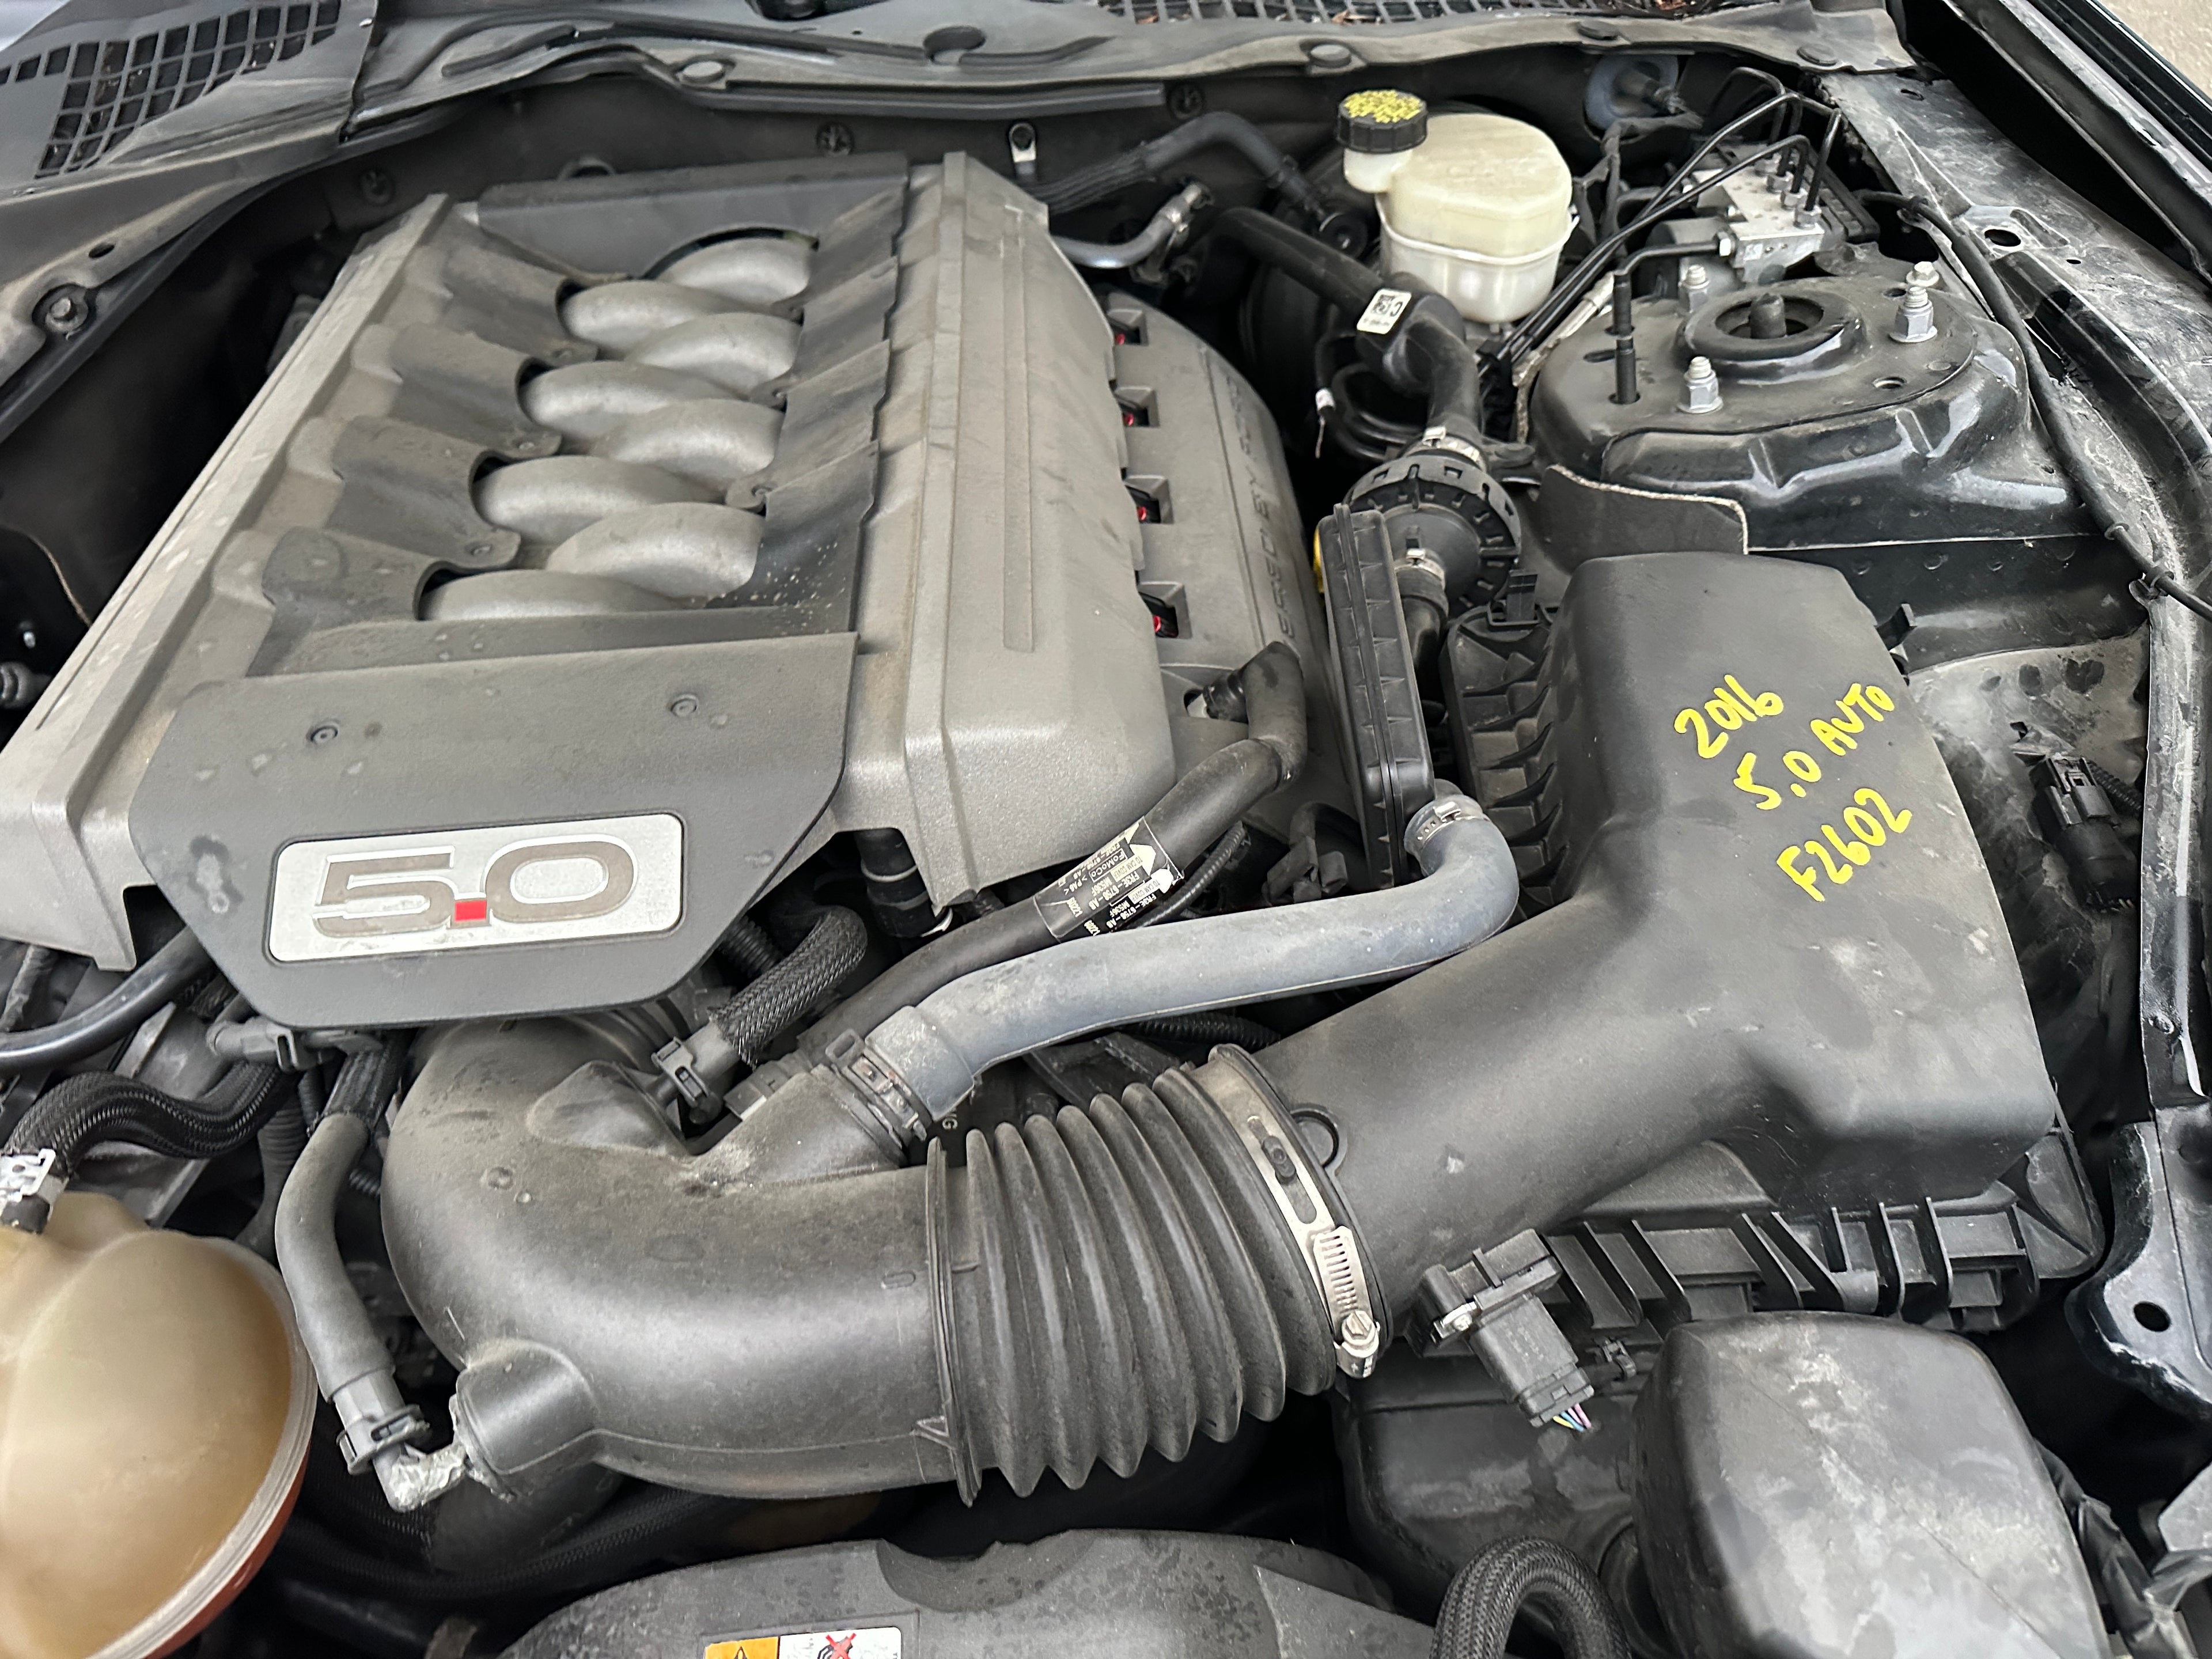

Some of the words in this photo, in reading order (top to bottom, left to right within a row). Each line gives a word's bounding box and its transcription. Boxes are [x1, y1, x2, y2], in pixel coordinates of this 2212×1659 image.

[1674, 675, 1783, 759] 2016
[1733, 751, 1821, 810] 5.0
[1810, 683, 1895, 756] AUTO
[312, 834, 638, 938] 5.0
[1091, 850, 1126, 877] FoMoCo
[1136, 856, 1143, 864] TO
[1777, 788, 1912, 902] F2602
